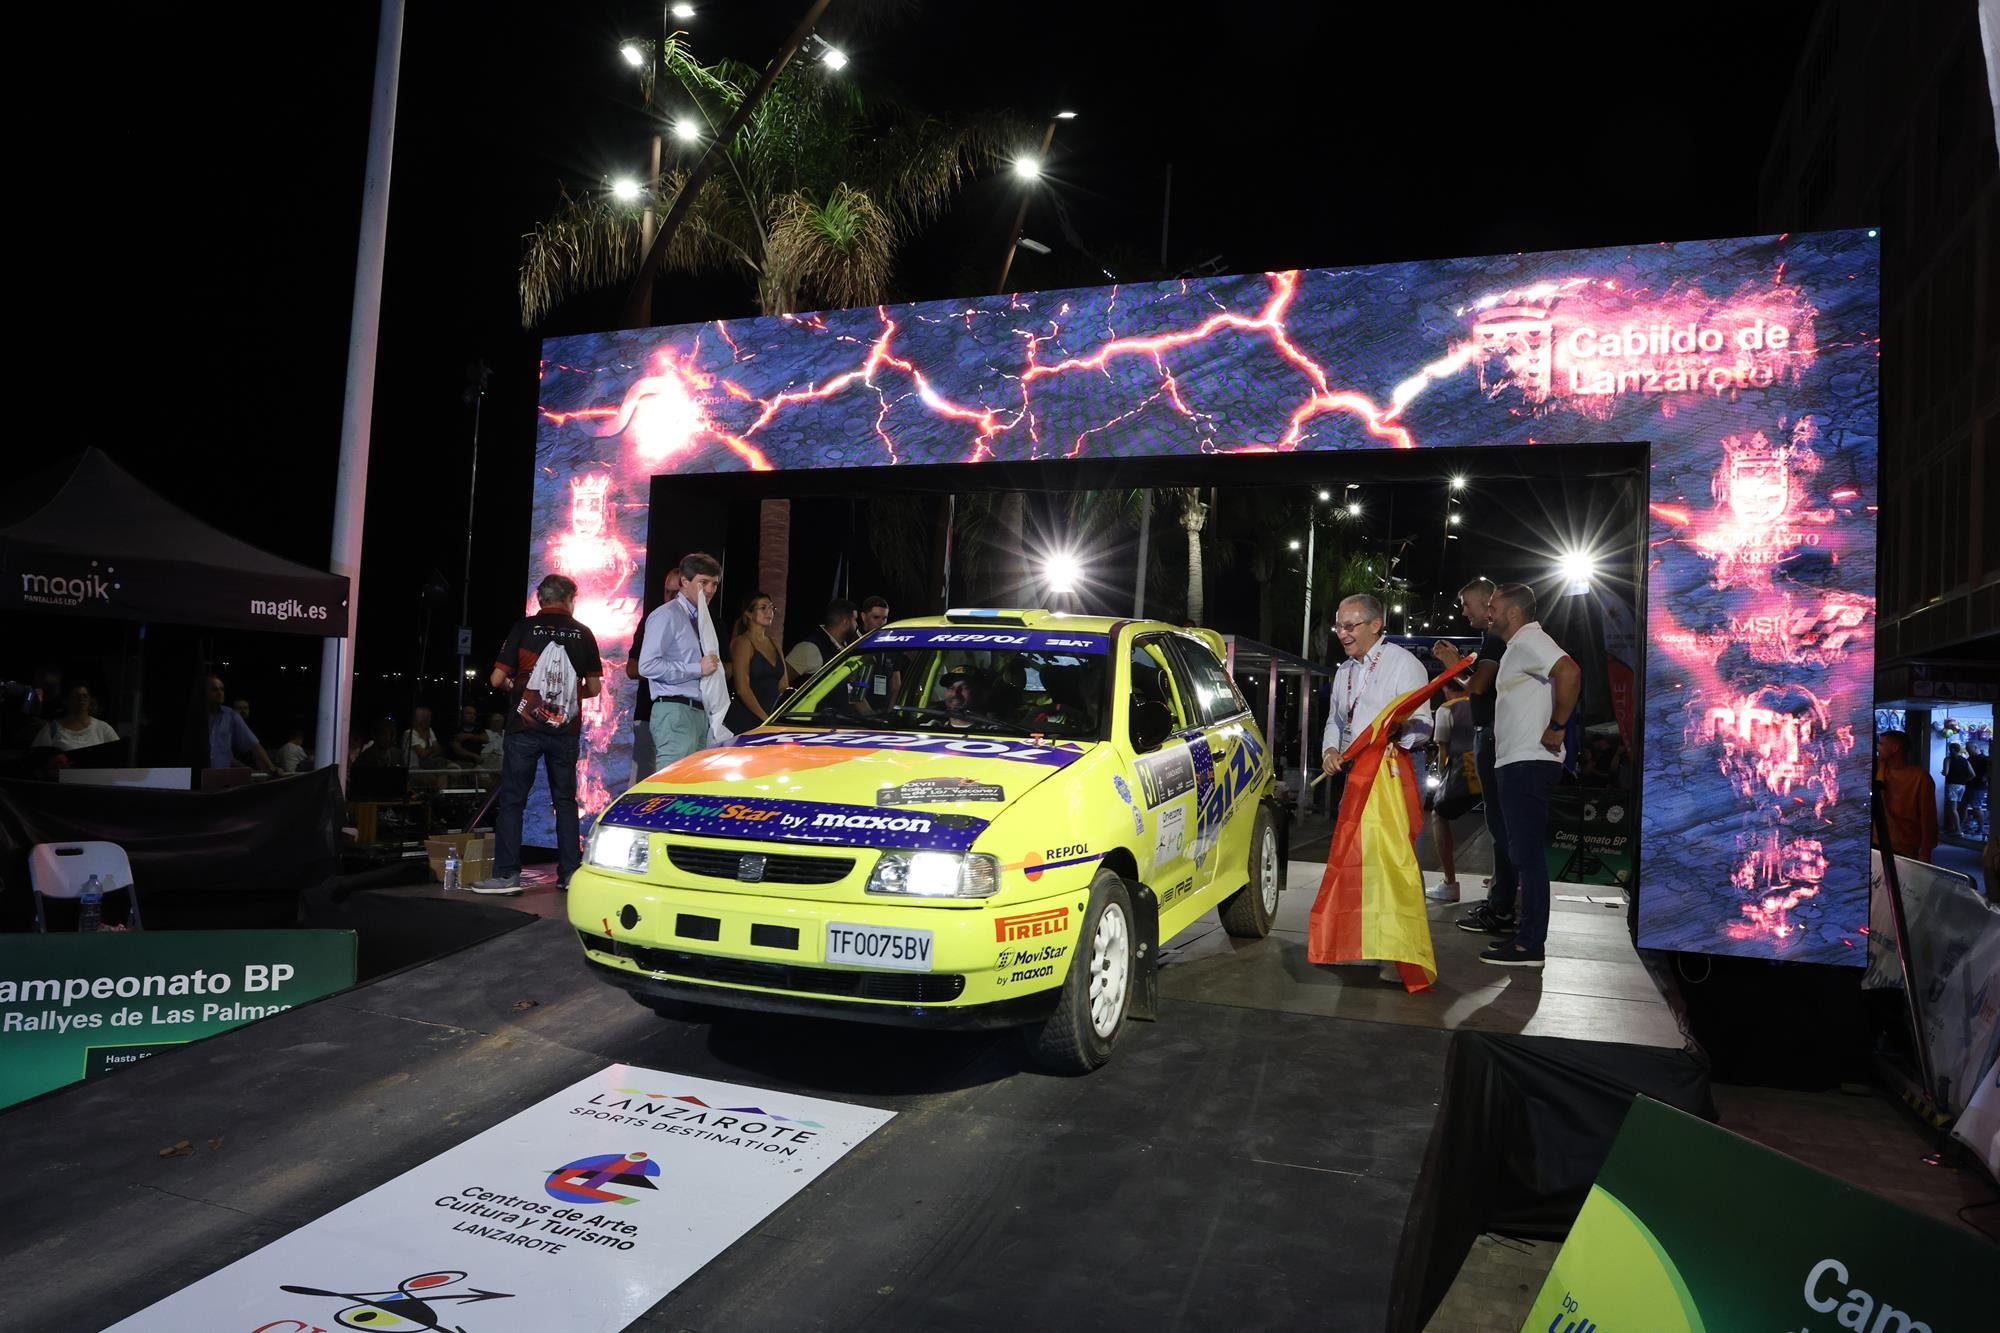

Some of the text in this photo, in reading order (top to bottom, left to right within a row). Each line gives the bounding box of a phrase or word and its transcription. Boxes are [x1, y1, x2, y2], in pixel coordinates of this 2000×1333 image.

[1567, 319, 1790, 358] Cabildo de
[1567, 360, 1774, 395] Lanzarote
[21, 574, 109, 602] magik
[24, 594, 77, 606] PANTALLAS LED
[250, 599, 327, 620] magik.es
[928, 633, 1030, 645] REPSOL
[1045, 637, 1093, 648] SEAT
[750, 732, 1053, 760] REPSOL
[664, 799, 932, 834] MoviStar by maxon
[1046, 843, 1089, 860] REPSOL
[1555, 830, 1611, 845] Camponato
[994, 906, 1069, 943] PIRELLI
[830, 929, 931, 961] TF0075BV
[1013, 945, 1068, 966] MoviStar
[0, 963, 295, 1007] ampeonato BP
[996, 964, 1054, 986] by maxon
[3, 1010, 103, 1034] Rallyes
[110, 1007, 144, 1027] de
[151, 1005, 196, 1025] Las
[106, 1053, 137, 1064] Hasta
[569, 1106, 798, 1156] SPORTS DESTINATION
[588, 1093, 817, 1144] LANZAROTE
[434, 1195, 635, 1251] Cultura y Turismo
[461, 1186, 639, 1238] Centros de Arte,
[452, 1221, 567, 1255] LANZAROTE
[1562, 1291, 1579, 1314] bp
[1804, 1258, 1933, 1333] Cam
